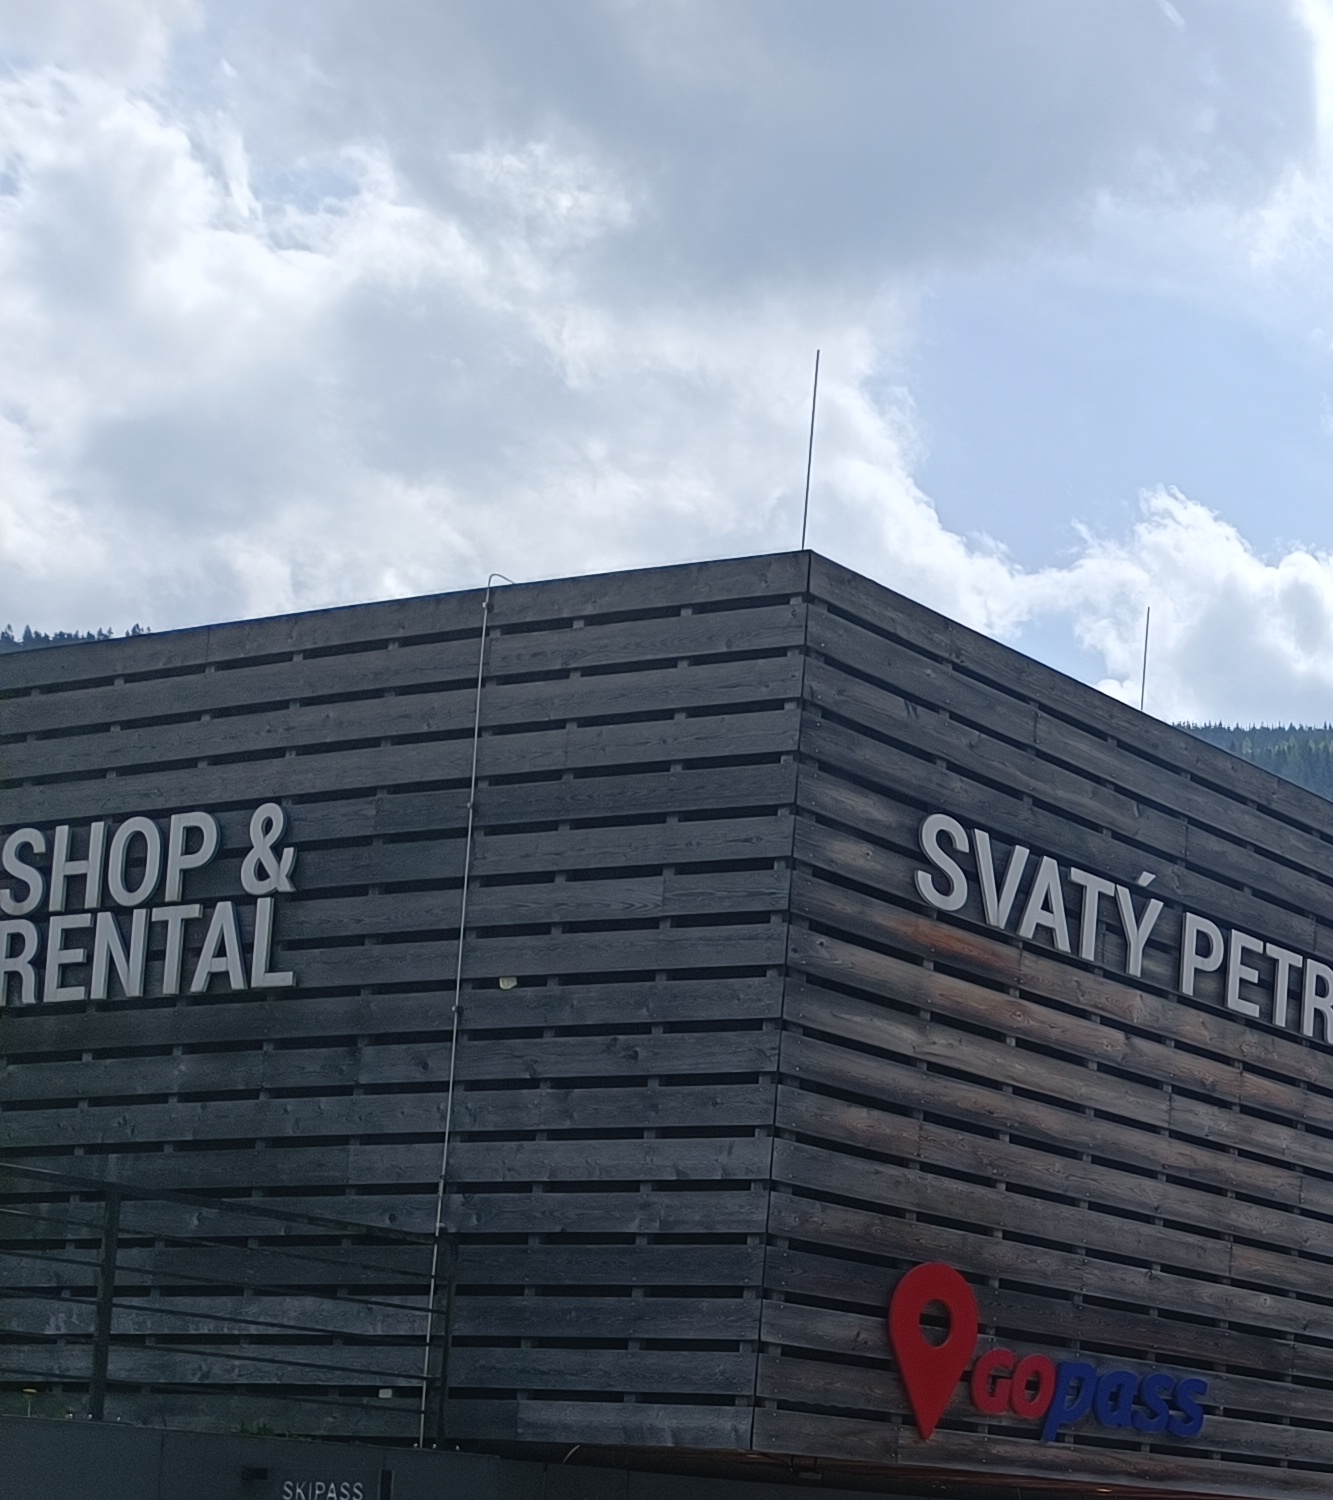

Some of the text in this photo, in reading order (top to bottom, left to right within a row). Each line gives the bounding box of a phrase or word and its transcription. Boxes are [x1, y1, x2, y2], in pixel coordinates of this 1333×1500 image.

[1, 803, 297, 916] SHOP &
[914, 813, 1164, 979] SVATÝ
[0, 897, 296, 1006] RENTAL
